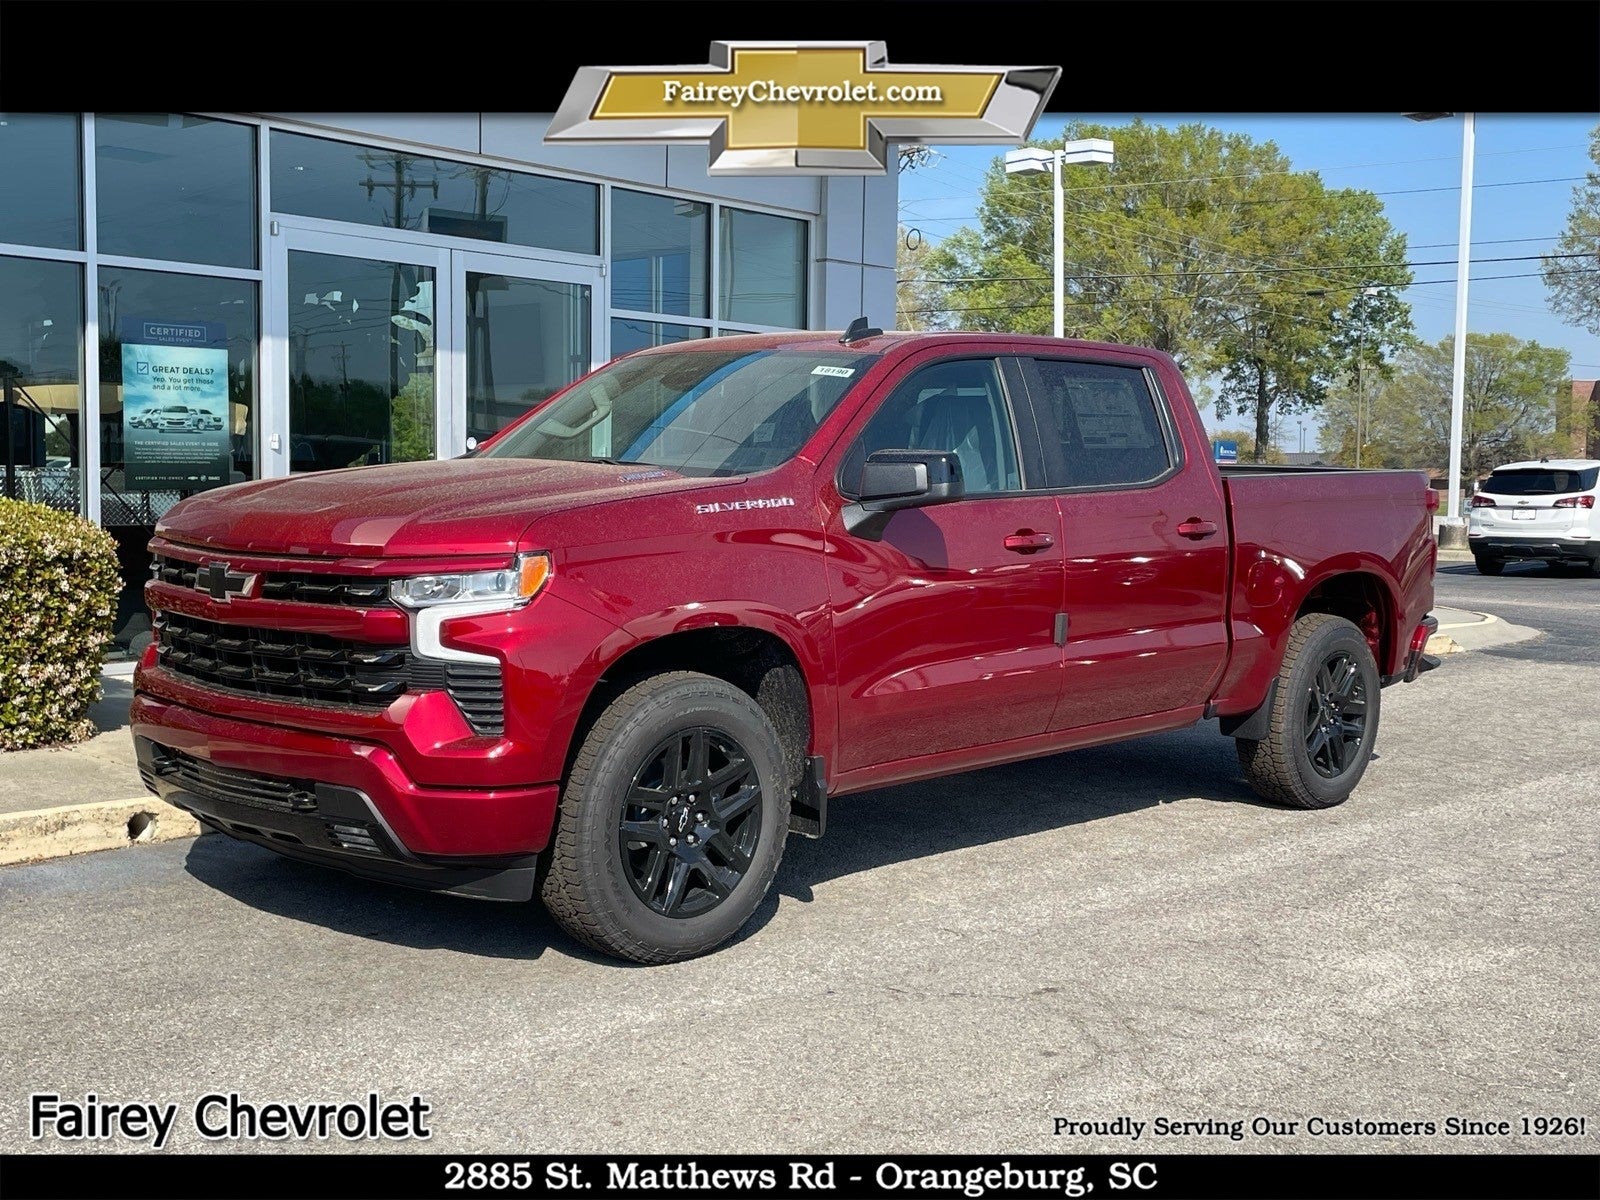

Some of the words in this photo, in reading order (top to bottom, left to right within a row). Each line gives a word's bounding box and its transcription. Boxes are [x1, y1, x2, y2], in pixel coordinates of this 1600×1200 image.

[149, 326, 201, 338] CERTIFIED
[152, 365, 180, 374] GREAT
[182, 366, 215, 376] DEALS?
[152, 376, 166, 384] Yep.
[696, 497, 795, 515] SILVERADO
